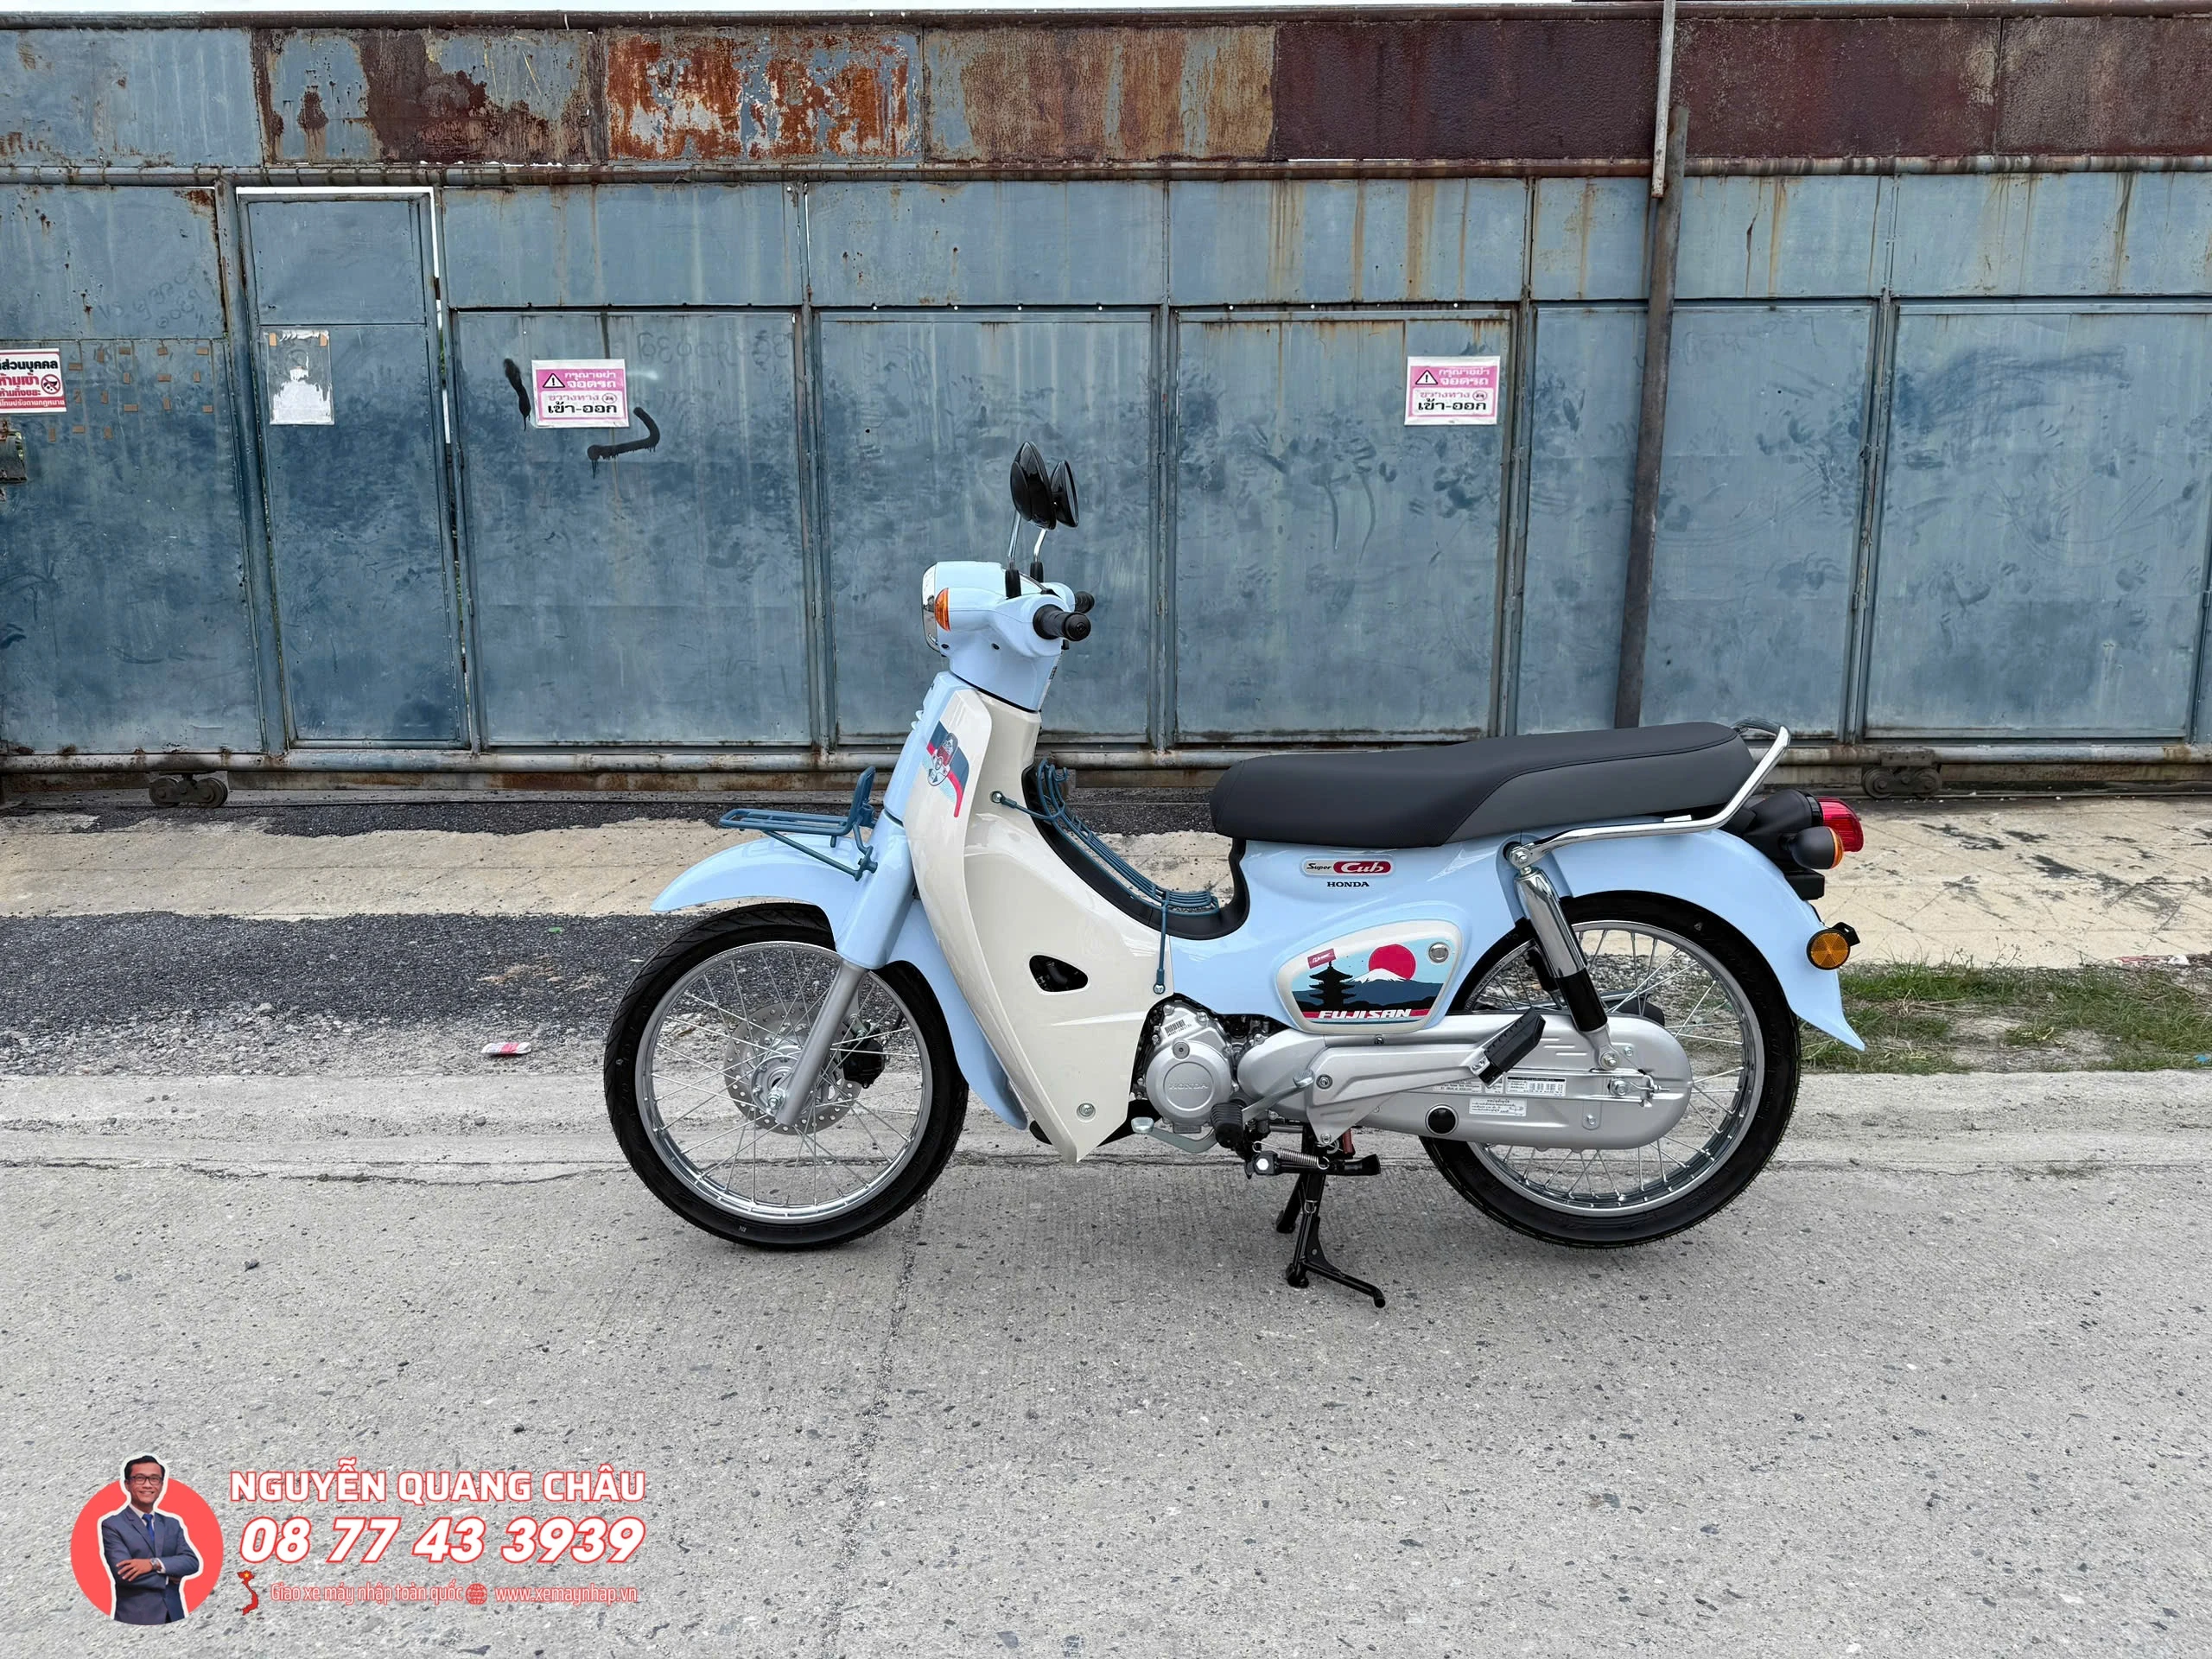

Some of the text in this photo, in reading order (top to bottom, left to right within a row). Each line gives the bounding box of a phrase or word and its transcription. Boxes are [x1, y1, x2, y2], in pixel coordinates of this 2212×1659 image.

[0, 359, 58, 372] ส่วนบุคคล
[548, 400, 618, 414] เข้า-ออก
[1418, 397, 1487, 410] เข้า-ออก
[1306, 862, 1384, 873] Super Cub
[1319, 1009, 1412, 1019] FUJISAN
